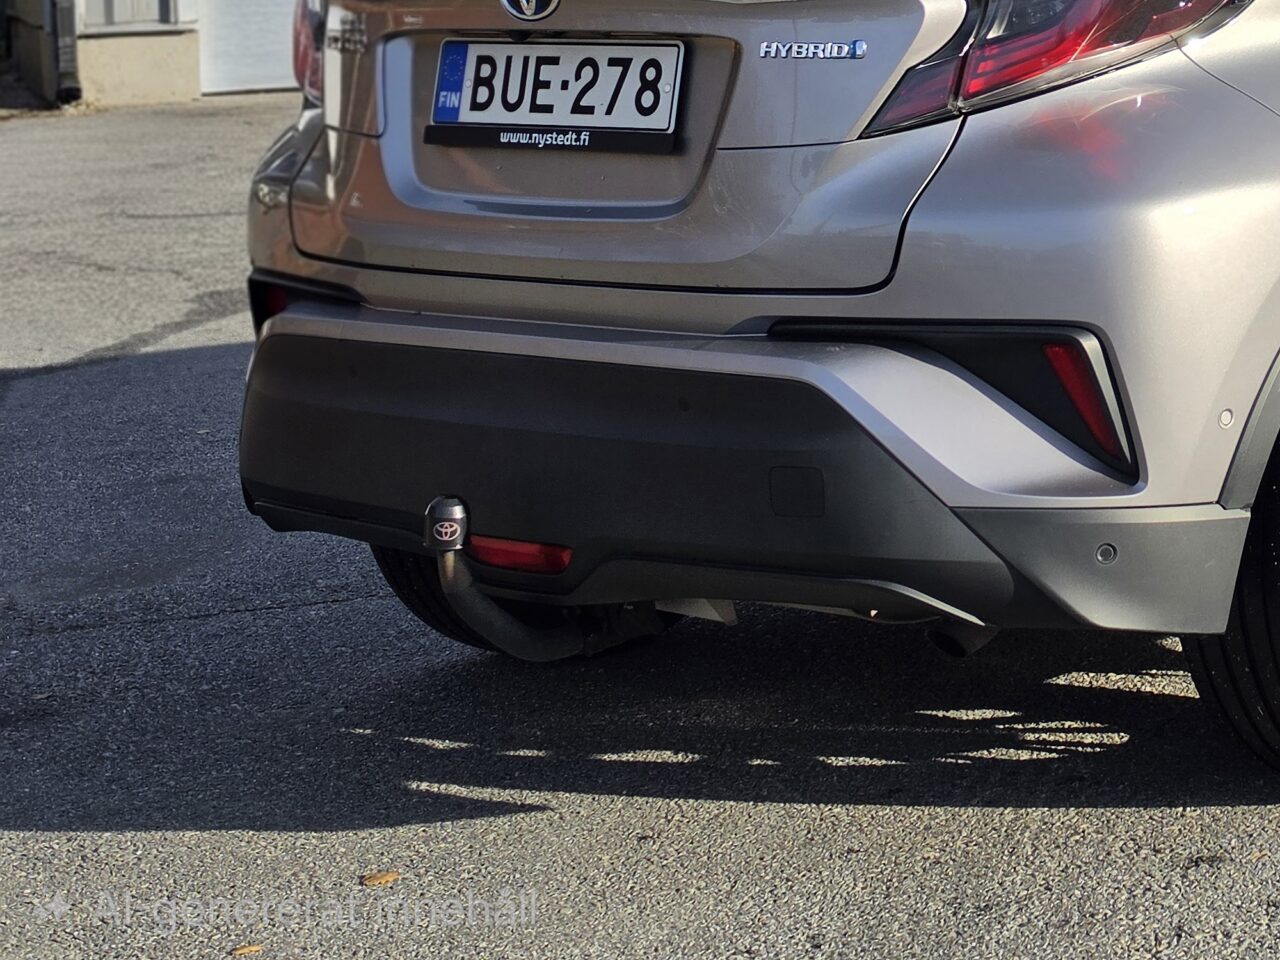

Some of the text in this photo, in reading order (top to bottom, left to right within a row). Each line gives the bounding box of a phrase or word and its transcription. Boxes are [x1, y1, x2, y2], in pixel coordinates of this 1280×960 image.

[759, 41, 849, 59] HYBRID
[438, 91, 461, 108] FIN
[499, 130, 590, 148] www.nystedt.fi
